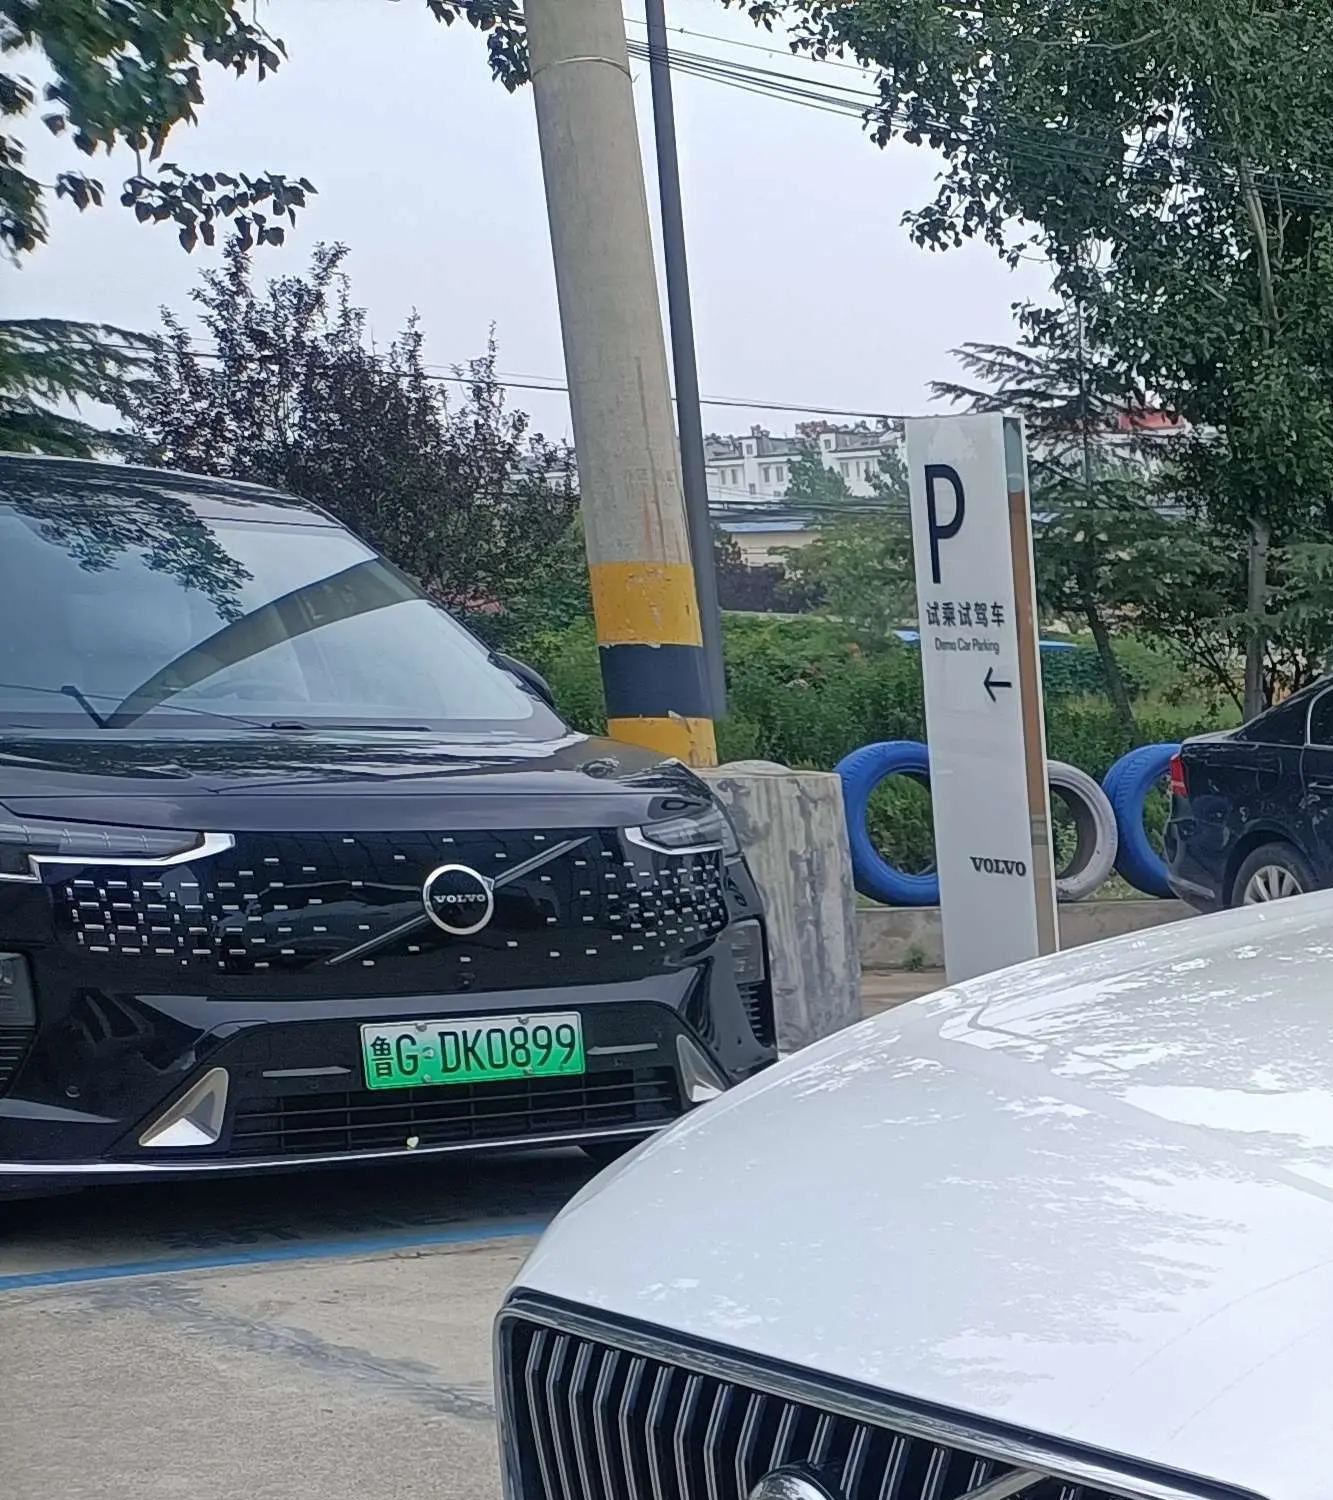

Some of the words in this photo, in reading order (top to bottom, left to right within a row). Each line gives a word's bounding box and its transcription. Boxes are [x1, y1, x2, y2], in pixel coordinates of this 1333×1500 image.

[924, 464, 966, 584] P
[926, 601, 1006, 627] 试乘试驾车
[934, 637, 957, 651] Demo
[957, 637, 971, 651] Car
[972, 638, 1000, 655] Parking
[969, 856, 1027, 877] VOLVO
[433, 894, 486, 903] VOLVO
